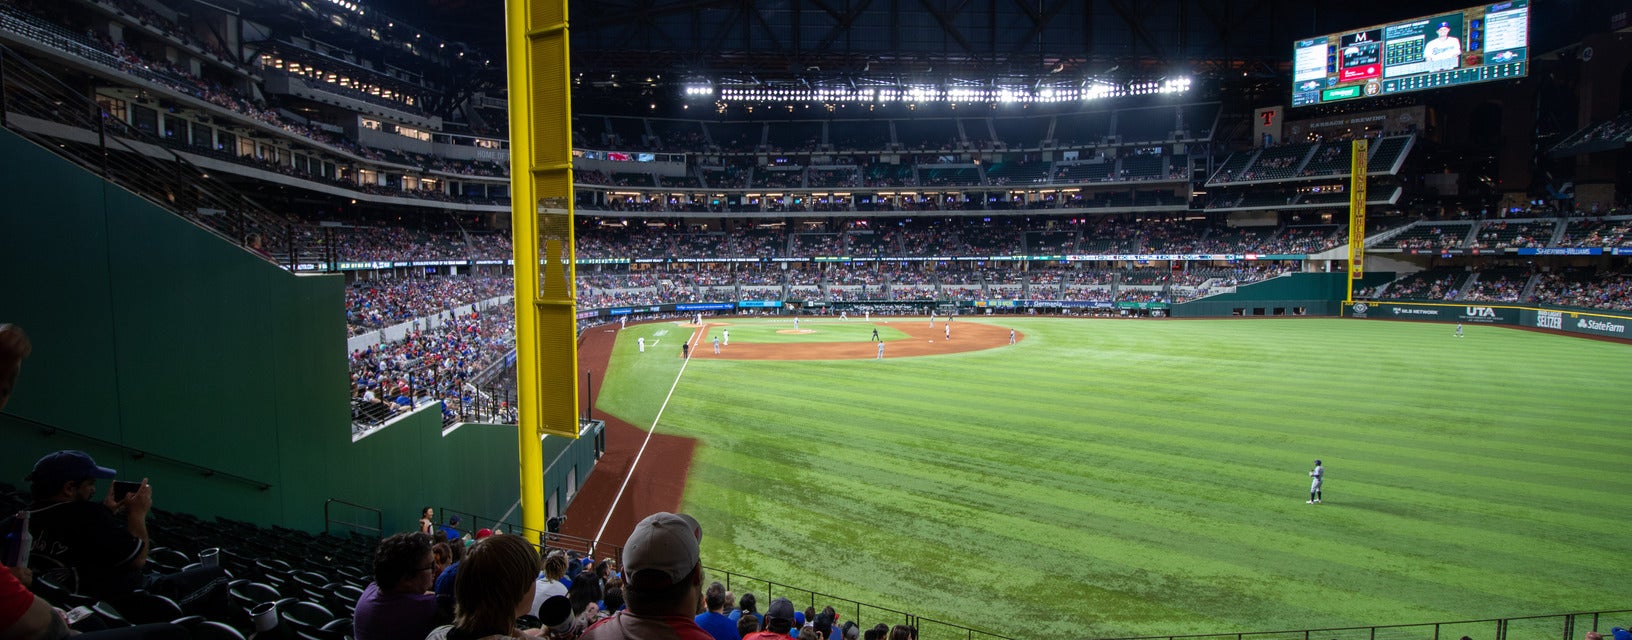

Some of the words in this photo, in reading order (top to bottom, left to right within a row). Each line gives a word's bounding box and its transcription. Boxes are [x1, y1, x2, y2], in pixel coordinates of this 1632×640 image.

[1260, 110, 1276, 126] T
[477, 151, 496, 159] HOME
[1466, 306, 1496, 317] UTA
[1537, 316, 1562, 329] SELTZER
